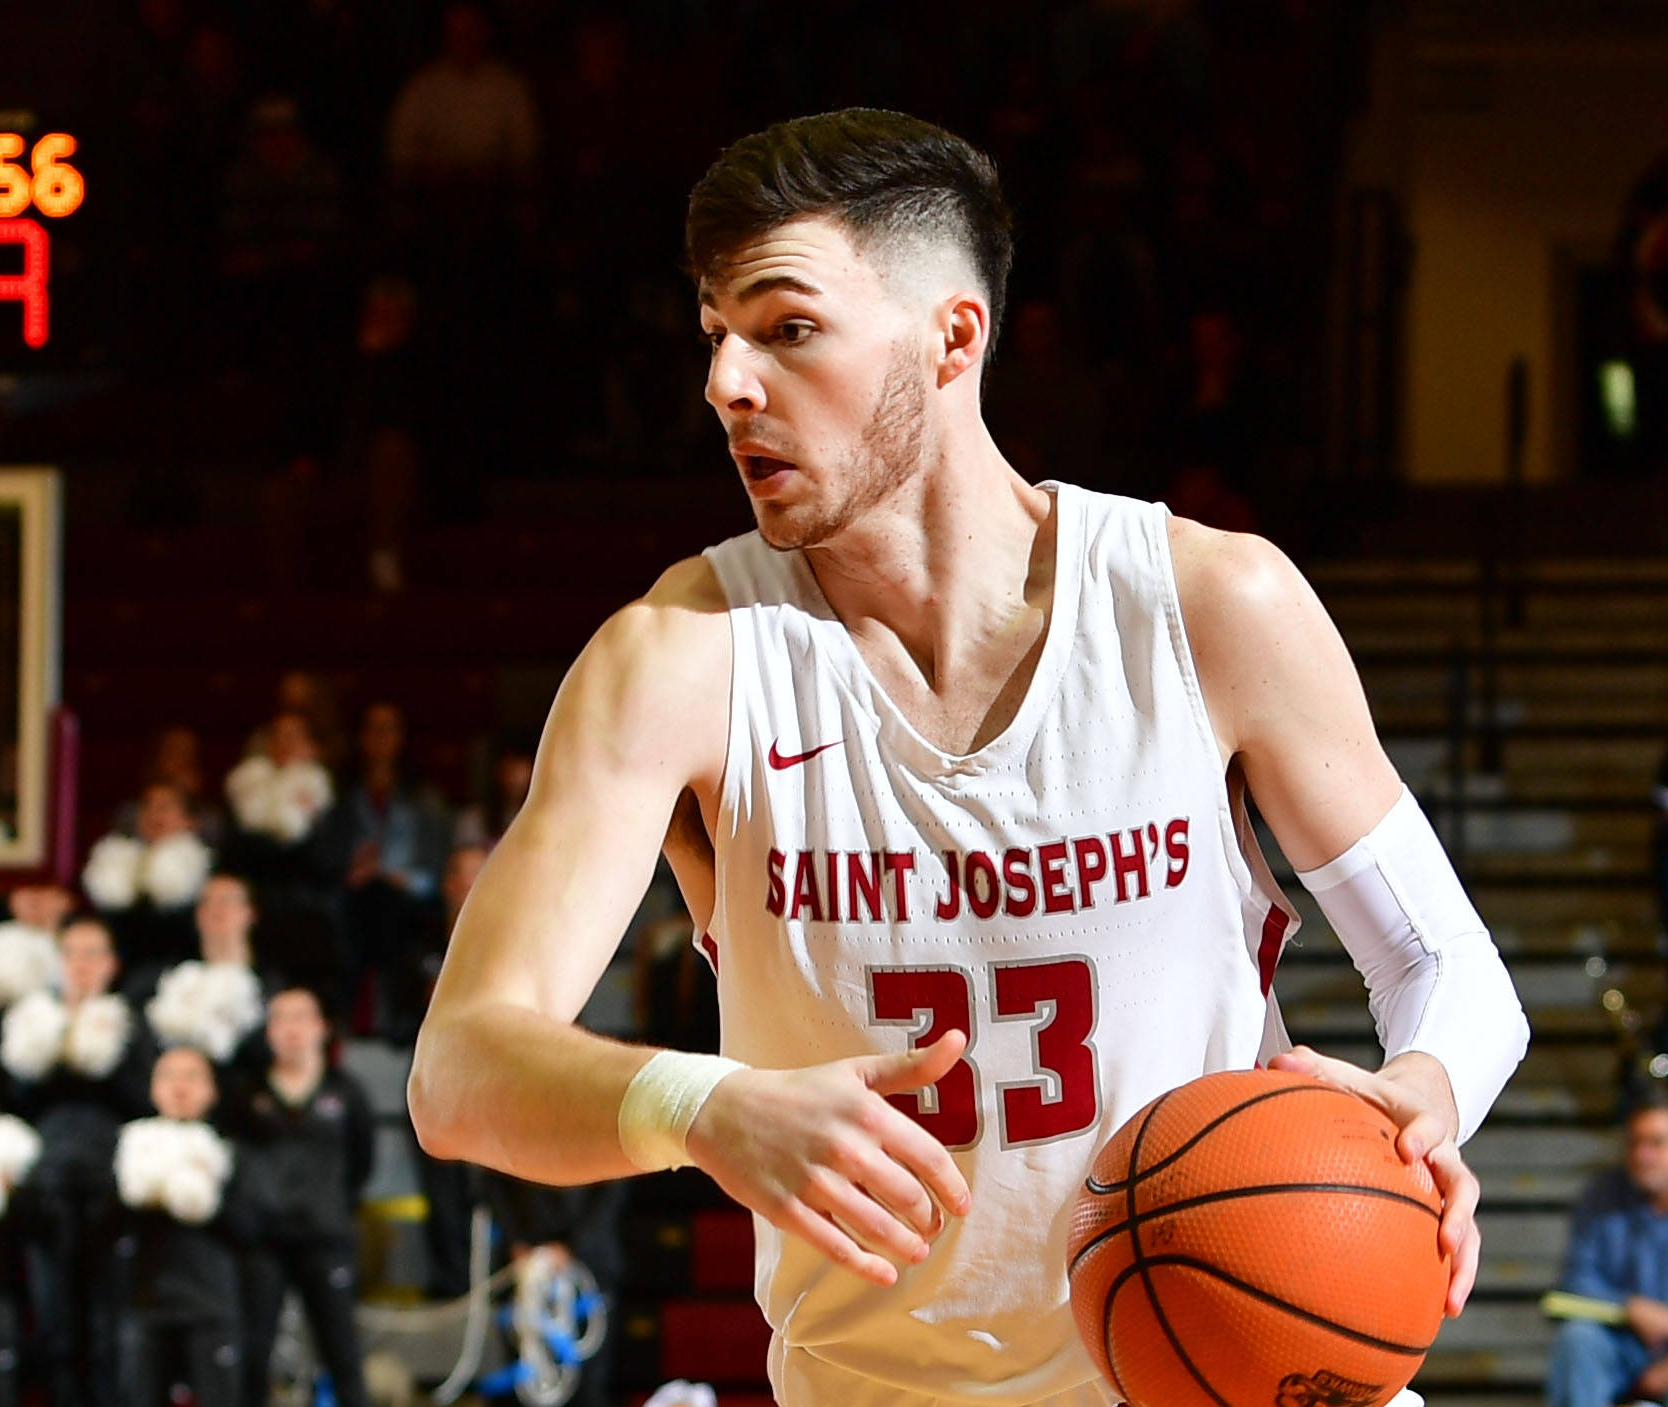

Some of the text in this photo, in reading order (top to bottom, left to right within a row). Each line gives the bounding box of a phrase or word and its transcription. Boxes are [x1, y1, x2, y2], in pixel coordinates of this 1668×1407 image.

[766, 816, 1192, 924] SAINT JOSEPH'S
[864, 953, 1104, 1152] 33
